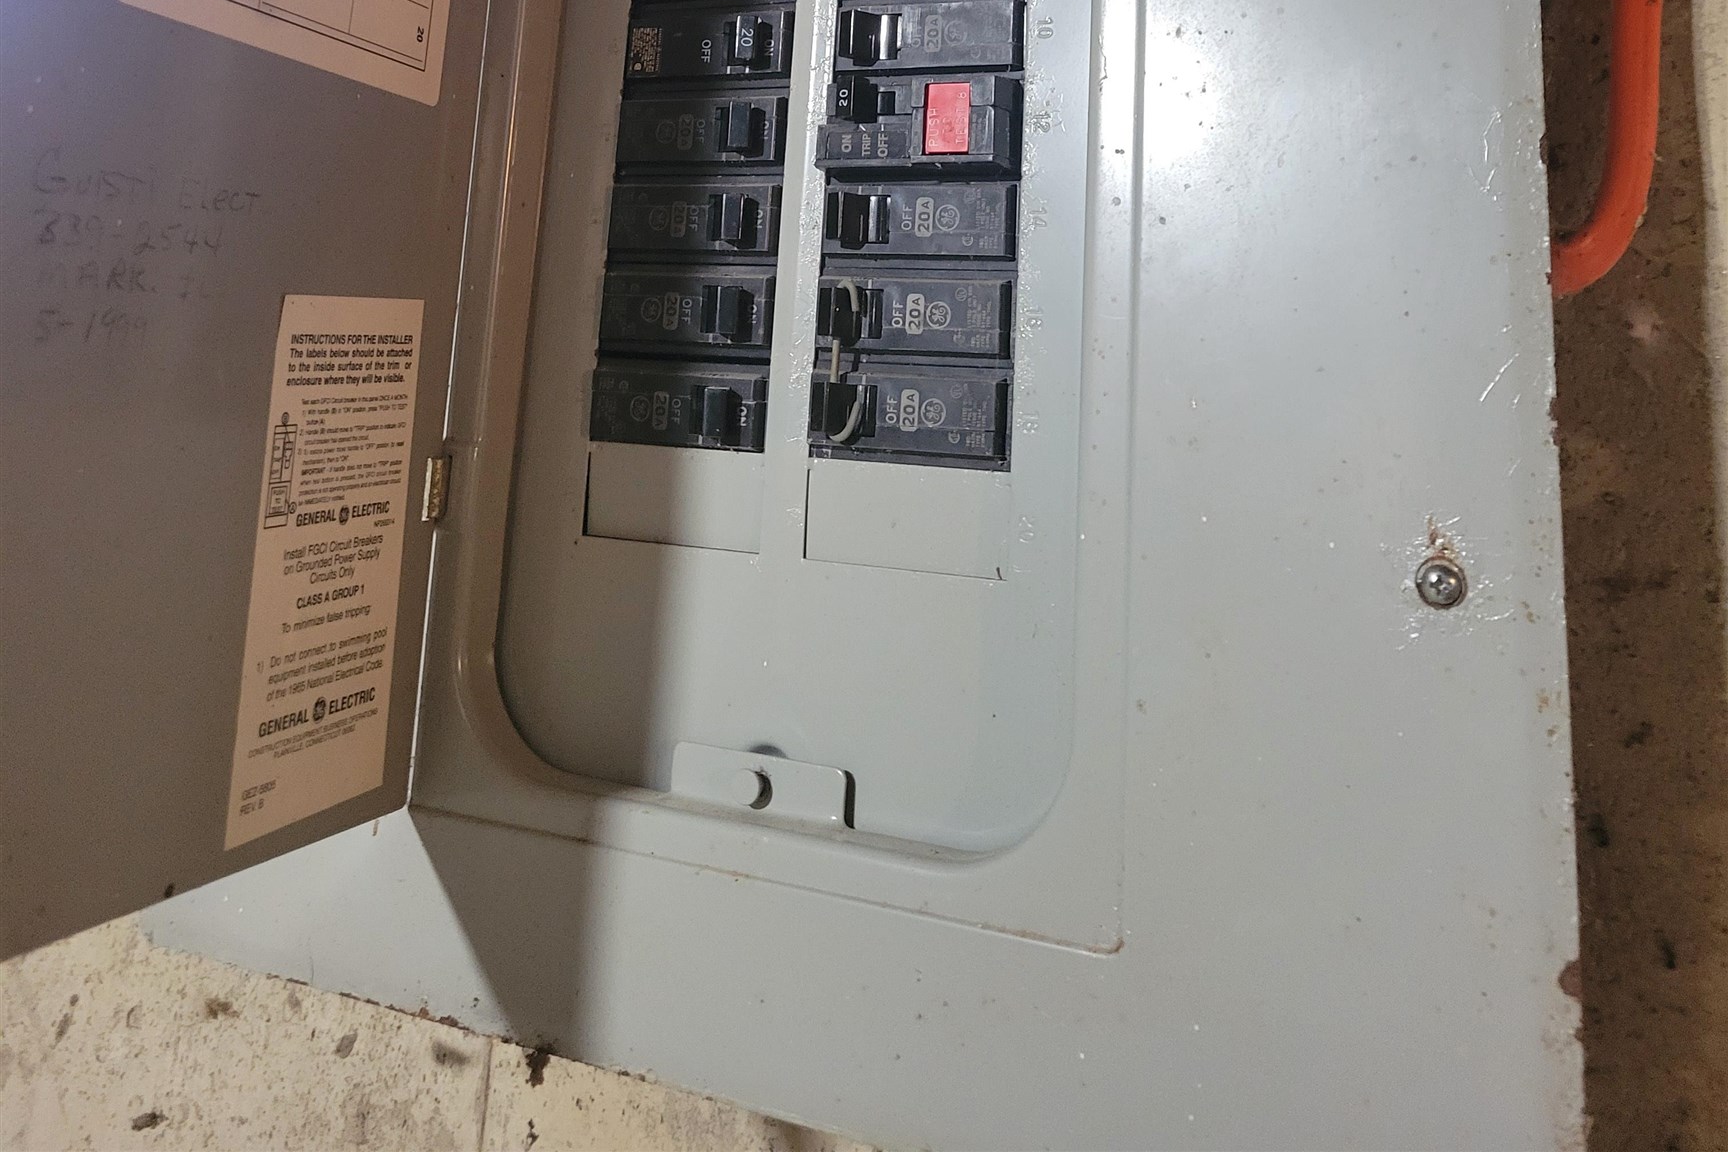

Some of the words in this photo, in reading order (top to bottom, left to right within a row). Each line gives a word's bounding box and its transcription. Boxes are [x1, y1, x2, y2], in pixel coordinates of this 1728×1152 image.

[416, 25, 424, 42] 20
[740, 28, 754, 47] 20
[926, 17, 940, 48] 20A
[701, 39, 712, 64] OFF
[764, 39, 775, 57] ON
[838, 88, 849, 107] 20
[696, 119, 706, 144] OFF
[928, 108, 939, 147] PUSH
[956, 107, 967, 144] TEST
[841, 134, 852, 153] ON
[862, 134, 872, 158] TRIP
[877, 134, 889, 158] OFF
[689, 207, 699, 231] OFF
[901, 204, 913, 231] OFF
[918, 200, 930, 232] 20A
[664, 294, 678, 328] 20A
[681, 299, 693, 325] OFF
[891, 300, 904, 328] OFF
[908, 297, 922, 330] 20A
[290, 334, 346, 344] INSTRUCTIONS
[346, 334, 362, 344] FOR
[362, 334, 376, 344] THE
[377, 334, 413, 344] INSTALLER
[289, 348, 303, 359] The
[305, 347, 327, 358] labels
[329, 347, 350, 358] below
[351, 347, 374, 358] should
[376, 347, 384, 357] be
[386, 347, 413, 357] attached
[287, 362, 296, 373] to
[298, 362, 310, 372] the
[312, 361, 335, 372] inside
[337, 360, 363, 371] surface
[364, 360, 372, 370] of
[374, 360, 385, 370] the
[387, 360, 400, 370] trim
[285, 375, 322, 386] enclosure
[323, 374, 344, 385] where
[345, 374, 360, 387] they
[361, 373, 373, 383] will
[373, 373, 382, 383] be
[654, 394, 667, 428] 20A
[671, 398, 682, 425] OFF
[886, 396, 899, 424] OFF
[902, 393, 916, 428] 20A
[295, 507, 337, 527] GENERAL
[351, 500, 390, 518] ELECTRIC
[296, 592, 323, 609] CLASS
[323, 590, 330, 602] A
[331, 584, 359, 600] GROUP
[360, 583, 364, 594] 1
[258, 708, 310, 737] GENERAL
[328, 686, 375, 715] ELECTRIC
